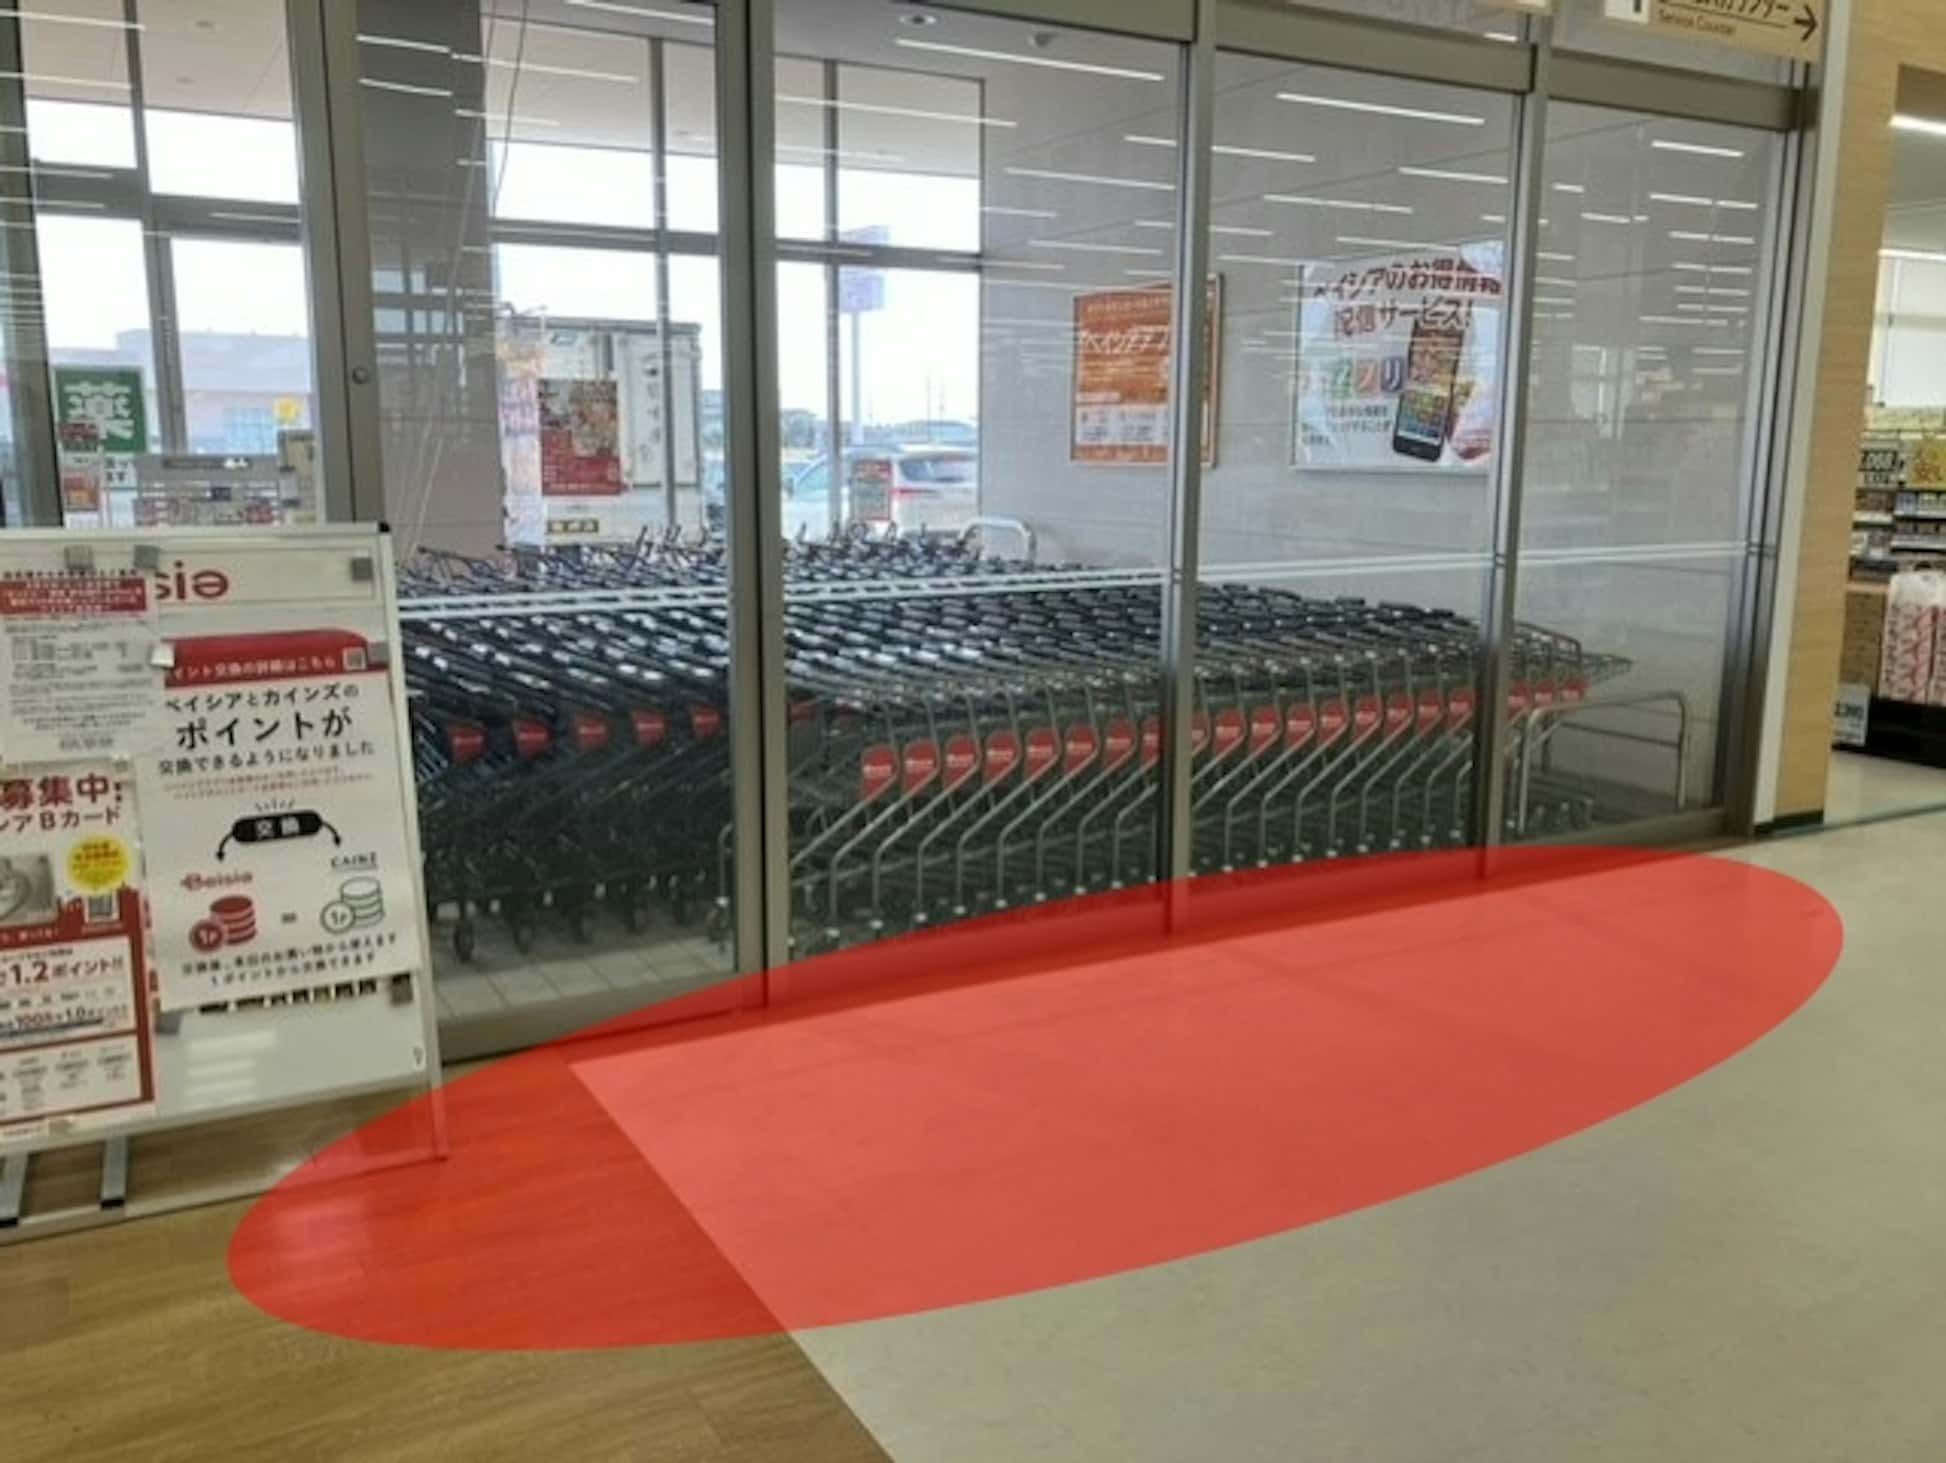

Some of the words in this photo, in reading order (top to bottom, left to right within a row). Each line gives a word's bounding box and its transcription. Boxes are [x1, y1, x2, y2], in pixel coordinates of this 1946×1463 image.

[165, 682, 360, 713] ベイシアとカインズの
[176, 705, 353, 750] ポイントが
[158, 739, 375, 776] 交換できるようになりました
